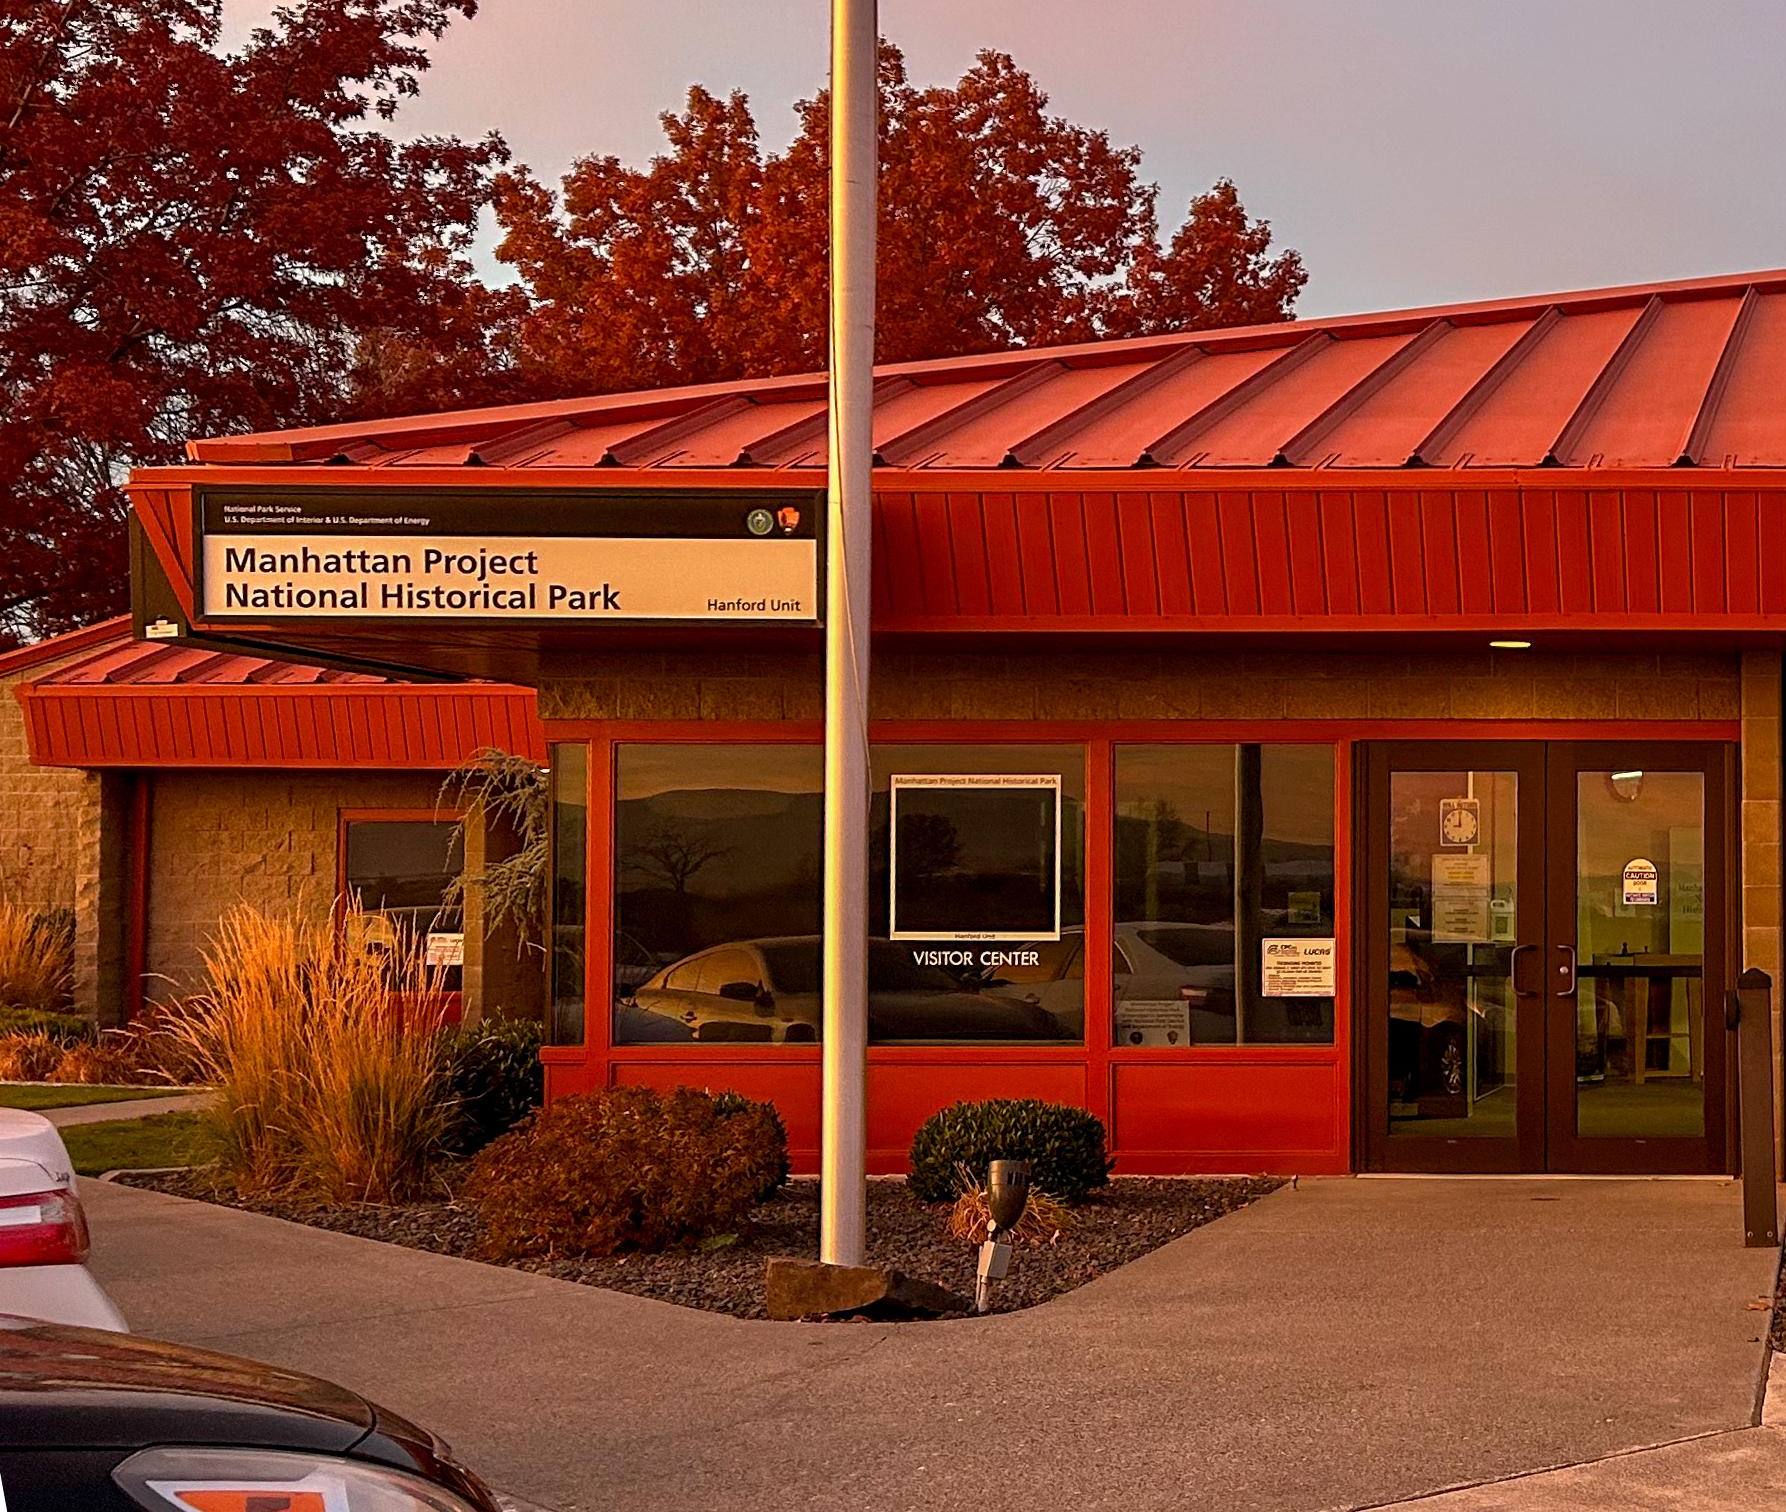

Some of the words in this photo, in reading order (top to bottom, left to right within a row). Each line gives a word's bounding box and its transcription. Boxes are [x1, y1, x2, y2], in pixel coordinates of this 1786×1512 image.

[224, 505, 256, 514] National
[257, 505, 274, 514] Park
[275, 505, 301, 514] Service
[224, 516, 239, 524] U.S.
[241, 516, 286, 525] Department
[287, 516, 295, 524] of
[296, 516, 324, 524] Interior
[325, 516, 331, 524] &
[333, 516, 348, 525] U.S.
[349, 517, 393, 526] Department
[394, 517, 402, 525] of
[404, 517, 430, 526] Energy
[225, 547, 412, 574] Manhattan
[424, 548, 539, 581] Project
[225, 582, 367, 609] National
[381, 583, 536, 610] Historical
[548, 584, 622, 611] Park
[707, 598, 766, 611] Hanford
[770, 599, 801, 612] Unit
[895, 777, 938, 785] Manhattan
[940, 777, 966, 786] Project
[968, 777, 1000, 785] National
[1002, 777, 1038, 785] Historical
[1040, 777, 1057, 785] Park
[1303, 948, 1331, 956] LUCAS
[913, 951, 974, 966] VISITOR
[980, 951, 1040, 966] CENTER
